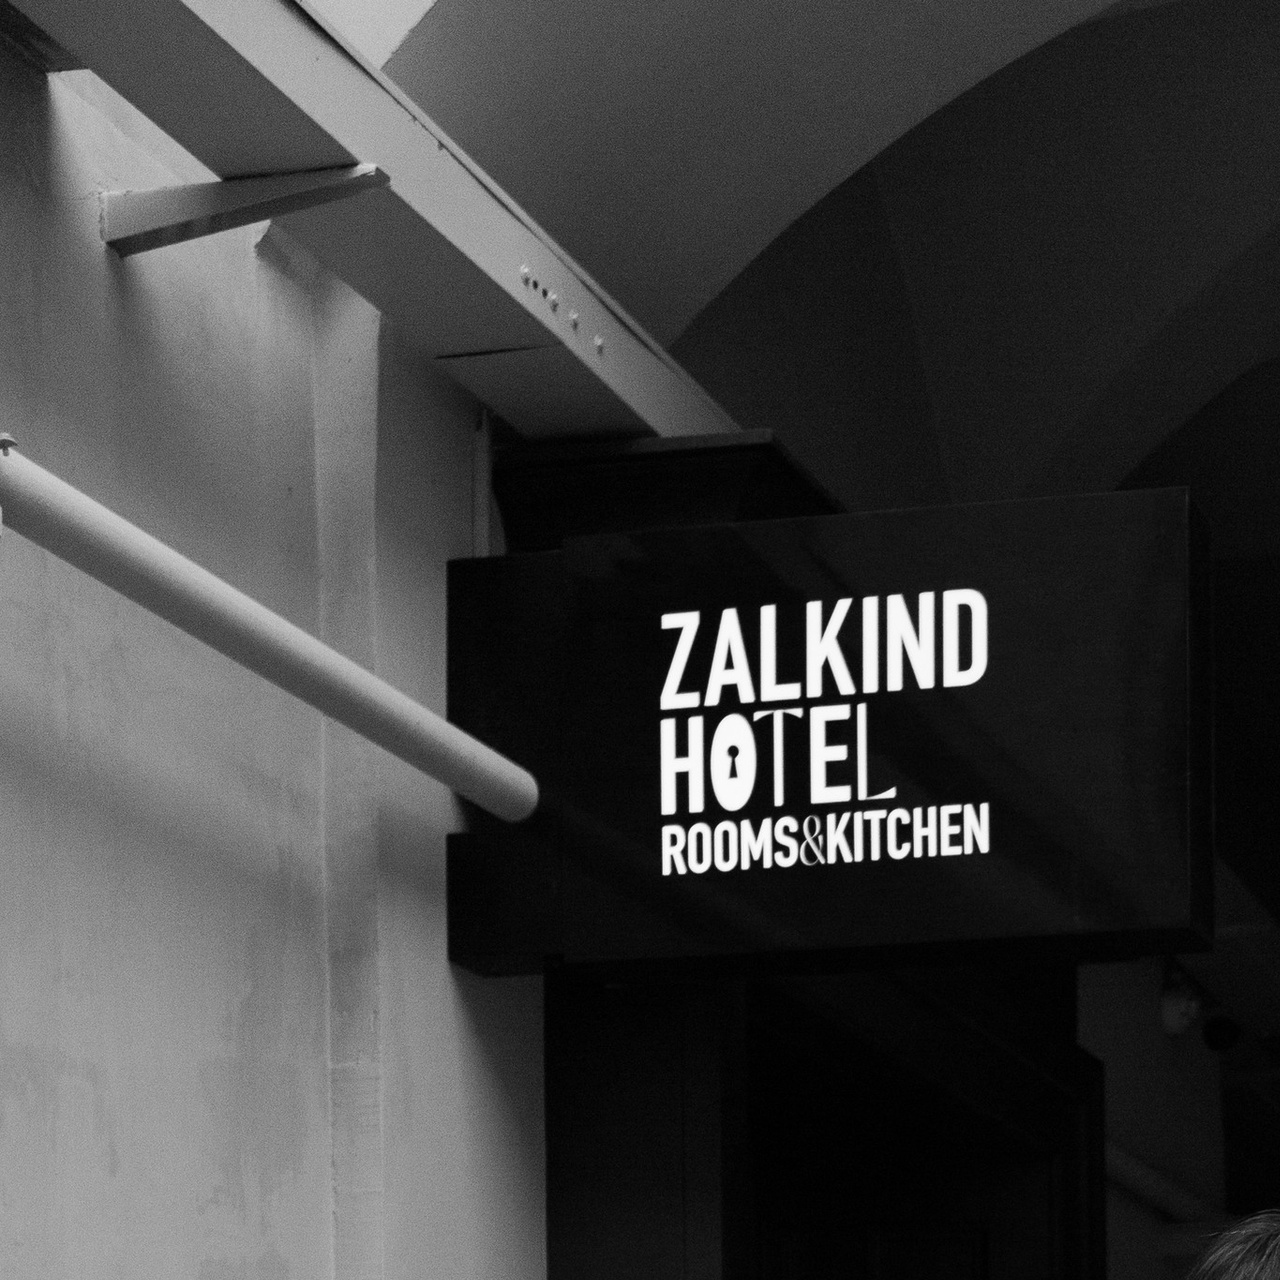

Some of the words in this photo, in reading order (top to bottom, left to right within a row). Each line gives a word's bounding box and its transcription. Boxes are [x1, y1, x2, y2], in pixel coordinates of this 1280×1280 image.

[660, 588, 988, 710] ZALKIND
[660, 702, 897, 816] HOTEL
[661, 802, 990, 877] ROOMS&KITCHEN
